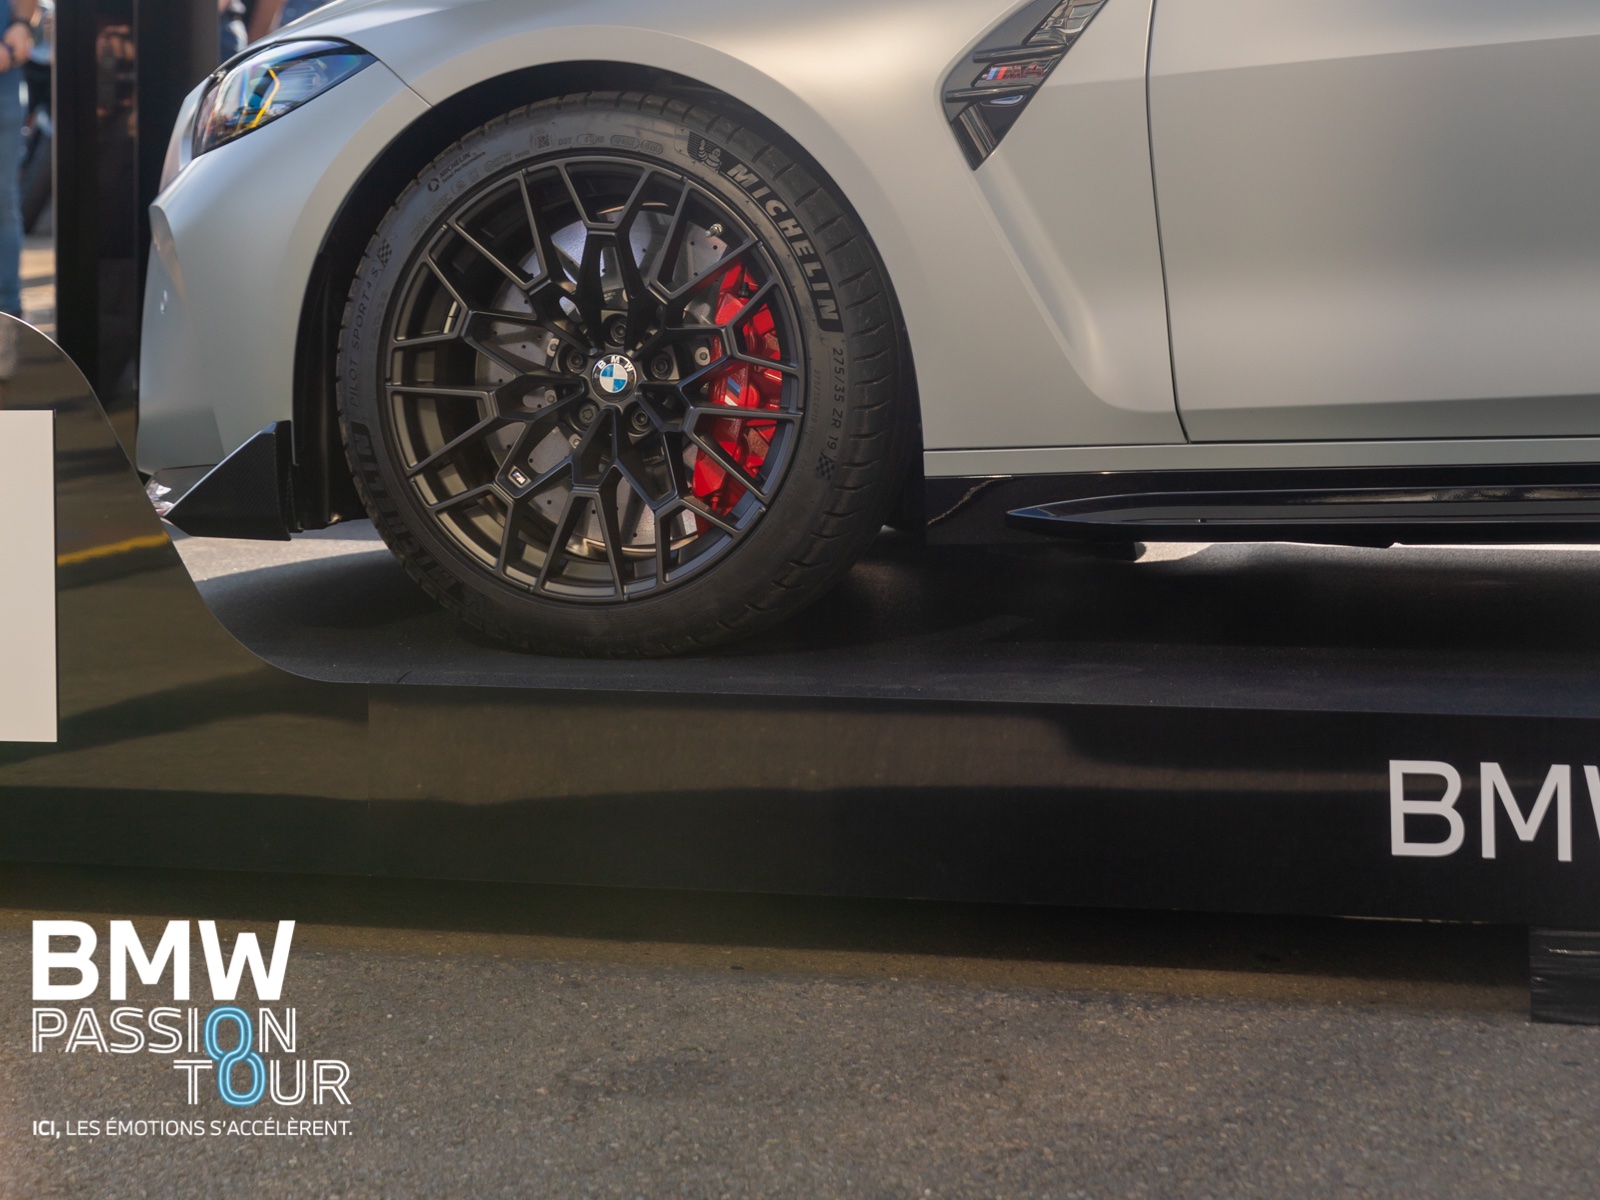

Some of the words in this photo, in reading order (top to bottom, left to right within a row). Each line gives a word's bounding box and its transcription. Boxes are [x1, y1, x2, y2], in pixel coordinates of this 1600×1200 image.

[437, 150, 473, 179] MICHELIN
[726, 157, 838, 324] MICHELIN
[368, 265, 380, 278] S
[350, 287, 372, 350] SPORT
[348, 359, 358, 407] PILOT
[598, 356, 634, 372] BMW
[832, 346, 845, 402] 275/35
[826, 434, 838, 450] 19
[830, 408, 843, 429] ZR
[353, 430, 456, 592] MICHELIN
[1389, 759, 1600, 862] BM
